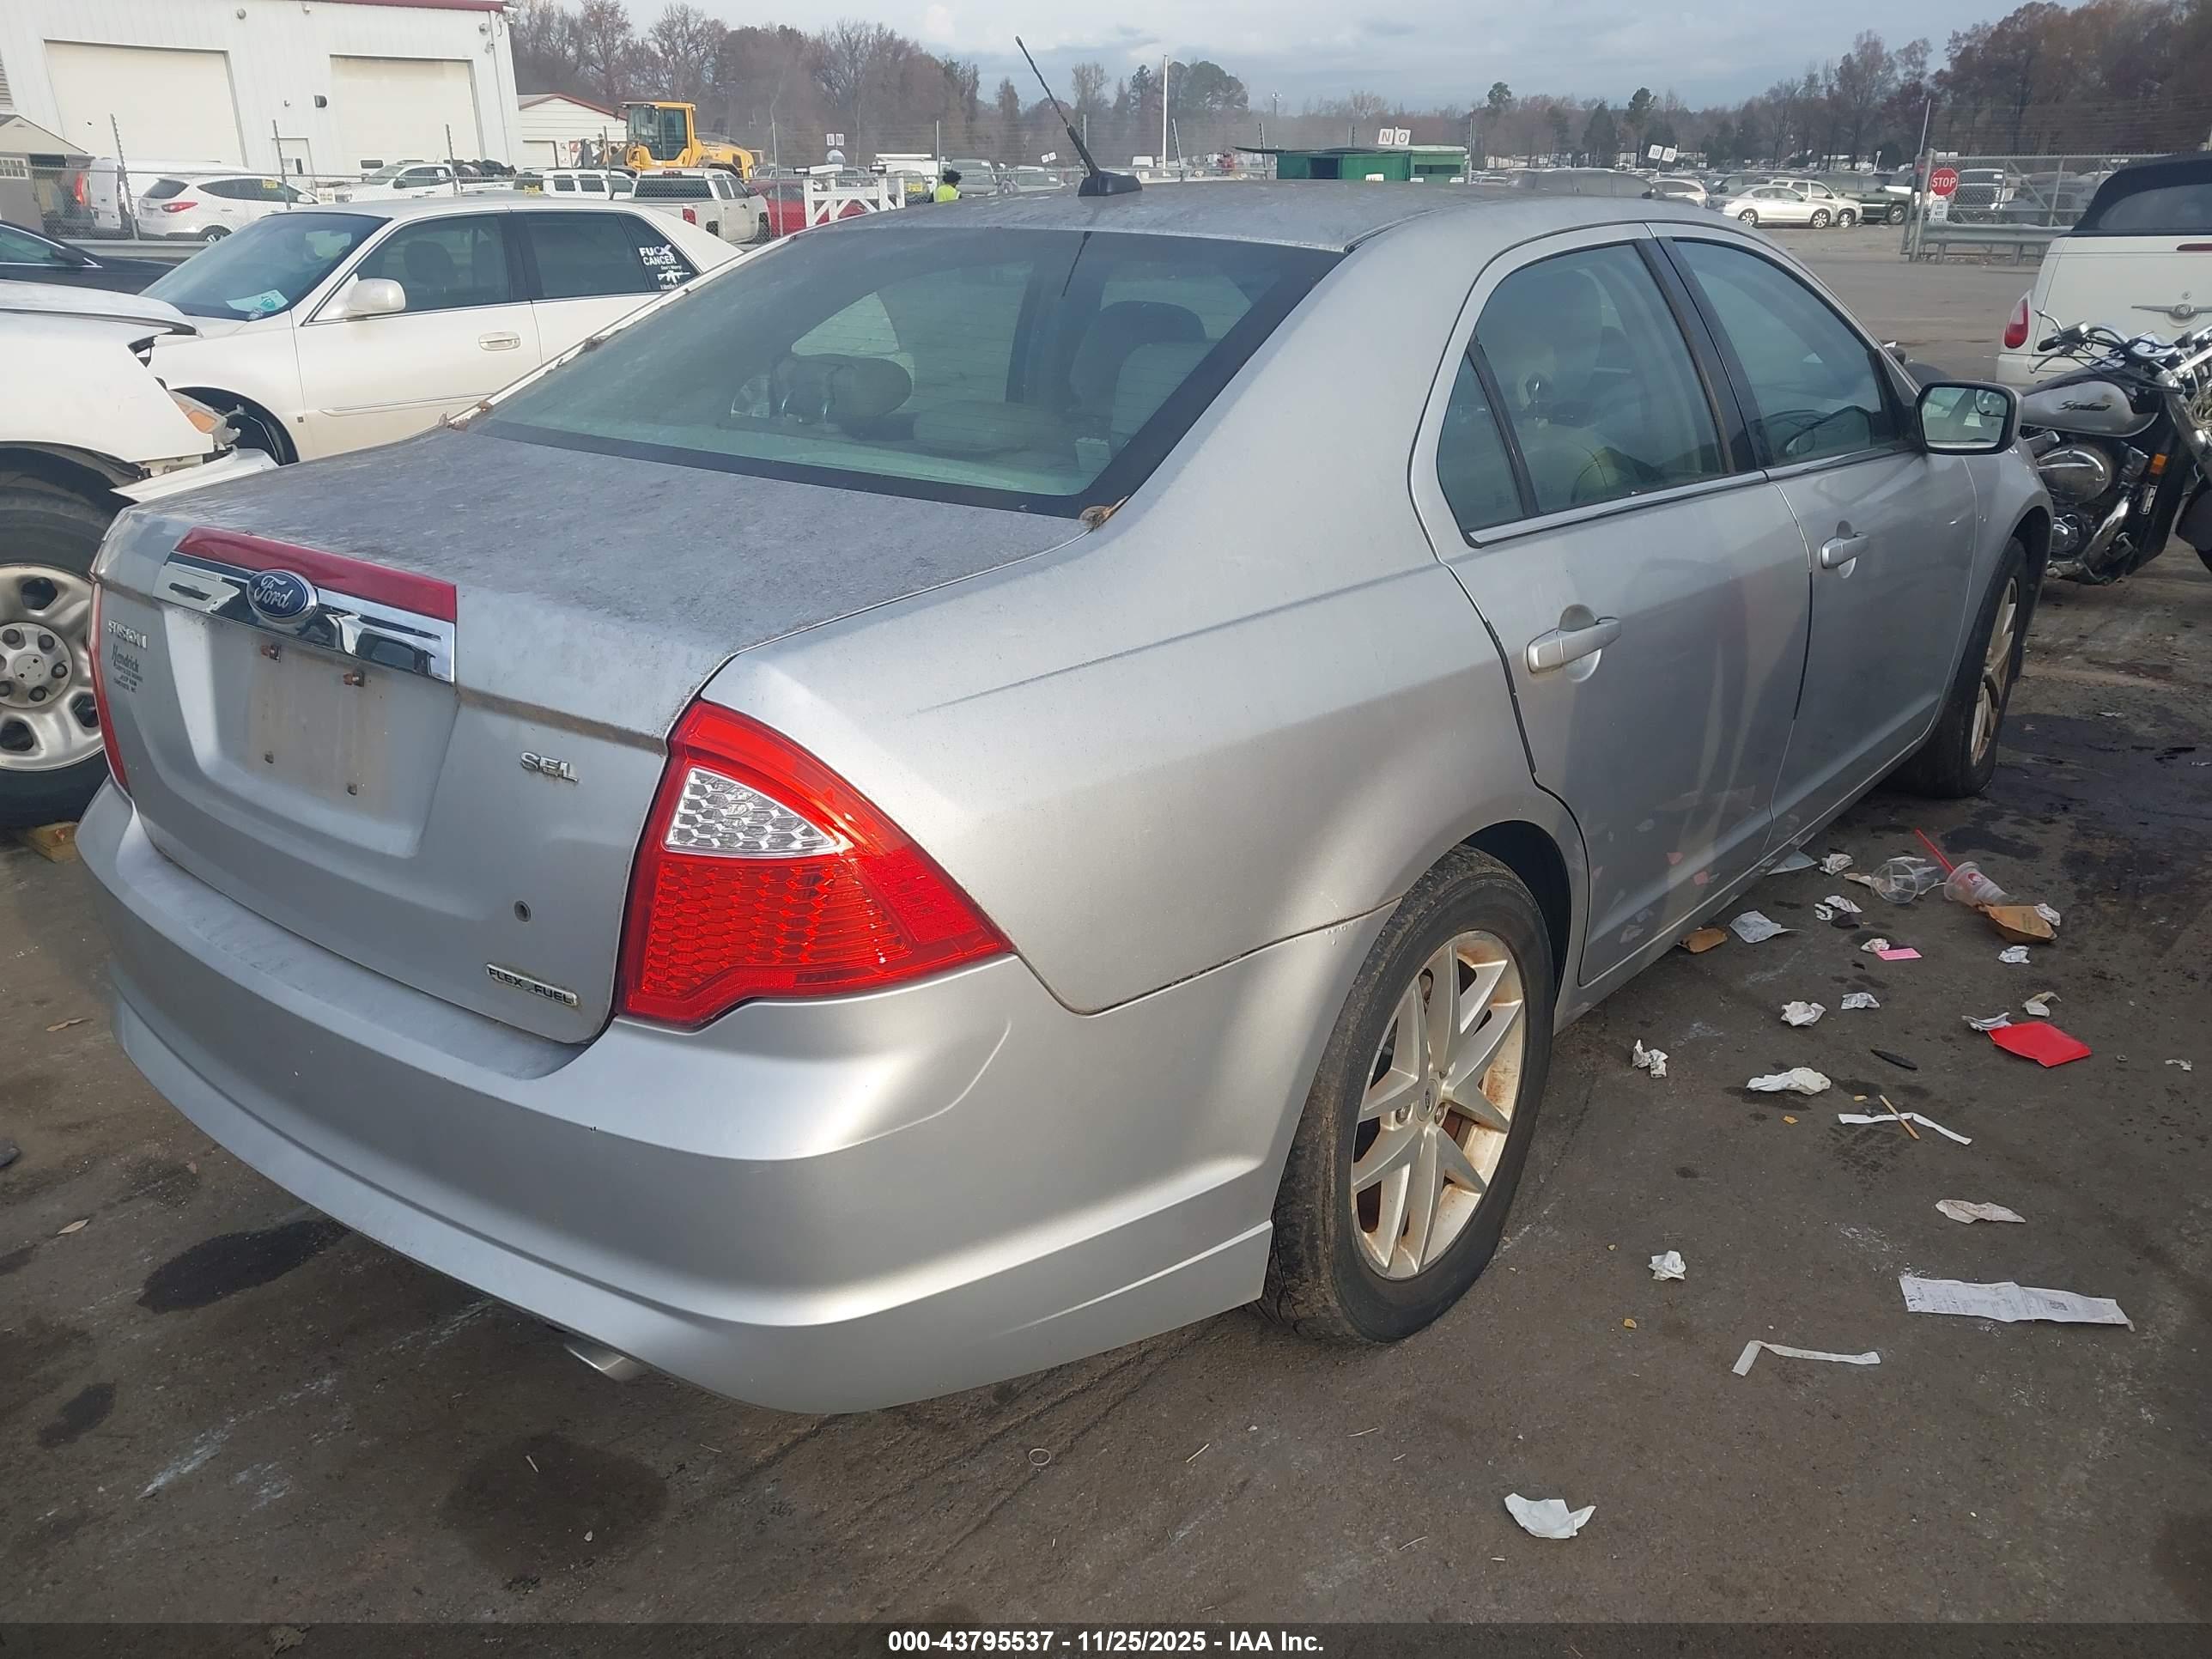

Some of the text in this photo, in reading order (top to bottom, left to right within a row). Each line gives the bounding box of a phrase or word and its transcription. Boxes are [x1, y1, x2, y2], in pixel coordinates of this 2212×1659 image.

[1932, 177, 1957, 187] STOP
[642, 255, 677, 265] CANCER
[253, 575, 295, 609] Ford
[520, 752, 578, 782] SEL
[489, 967, 574, 1005] FLEX FUEL
